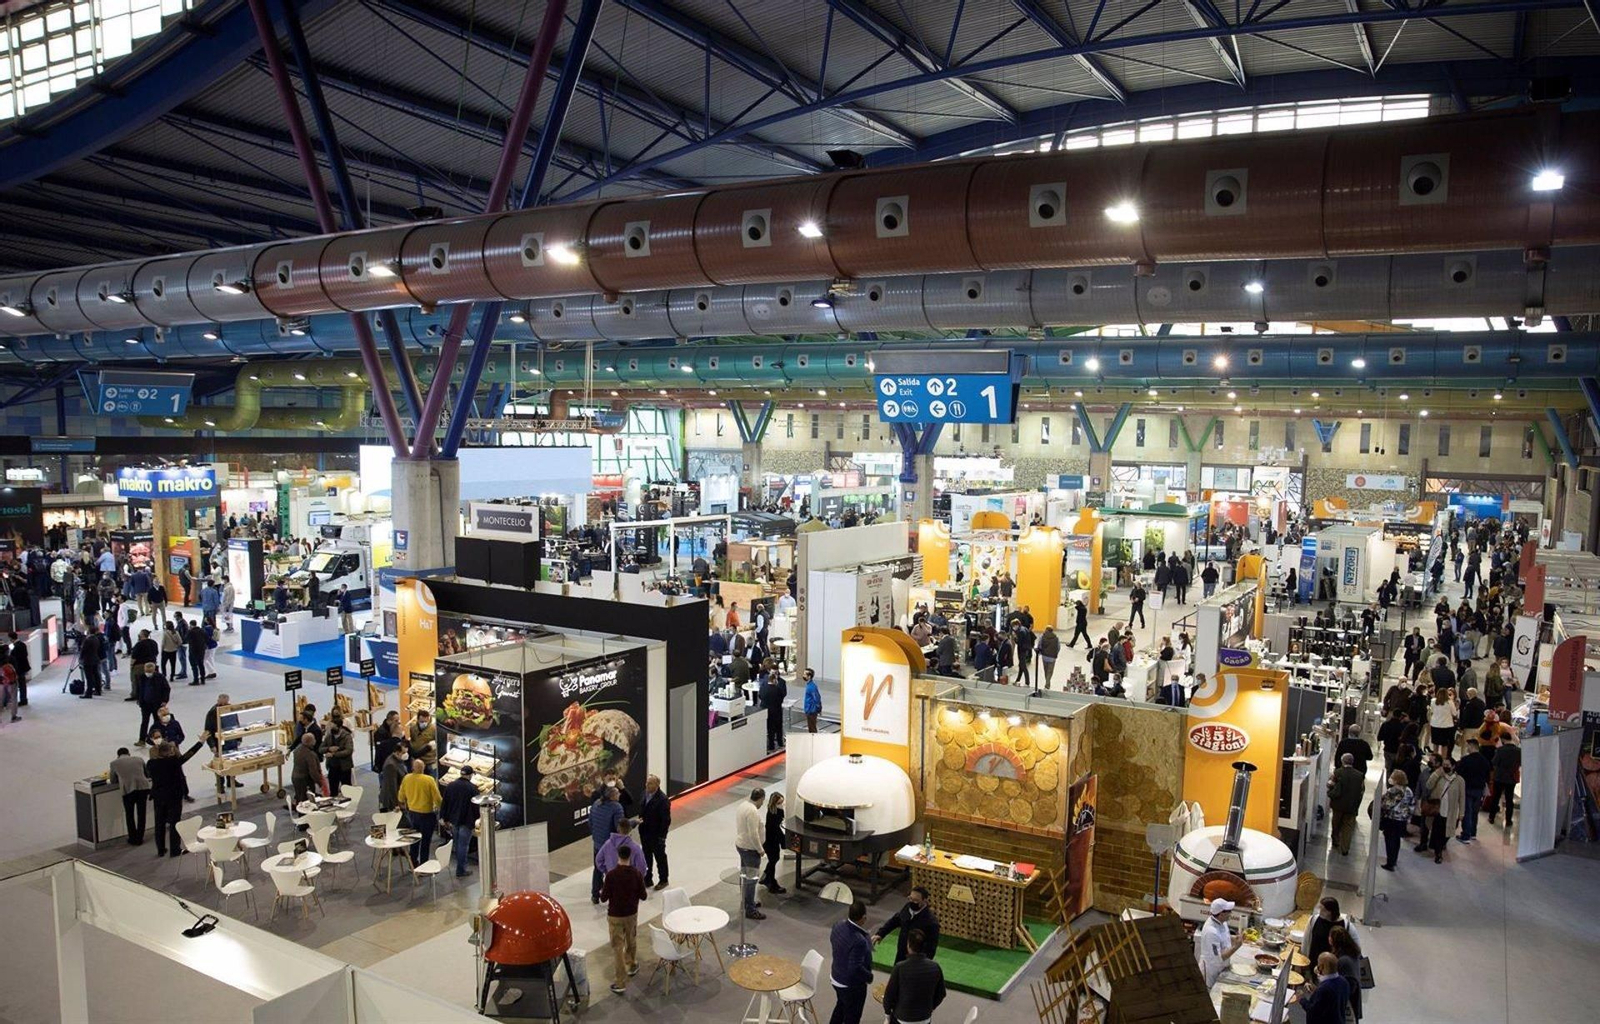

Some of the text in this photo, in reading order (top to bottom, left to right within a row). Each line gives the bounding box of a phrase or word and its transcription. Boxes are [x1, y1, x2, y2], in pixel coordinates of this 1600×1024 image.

[150, 388, 158, 400] 2
[170, 394, 180, 412] 1
[898, 378, 998, 418] Salida 2 1
[120, 476, 212, 492] makro makro
[483, 516, 526, 526] MONTECELIO
[1346, 550, 1356, 584] FROZEN
[1224, 656, 1250, 664] Cacao
[579, 670, 618, 686] Panamar
[580, 679, 618, 694] BAKERY GROUP
[1548, 710, 1566, 719] H&T
[1192, 734, 1246, 751] Stagioni
[1213, 730, 1224, 741] 5
